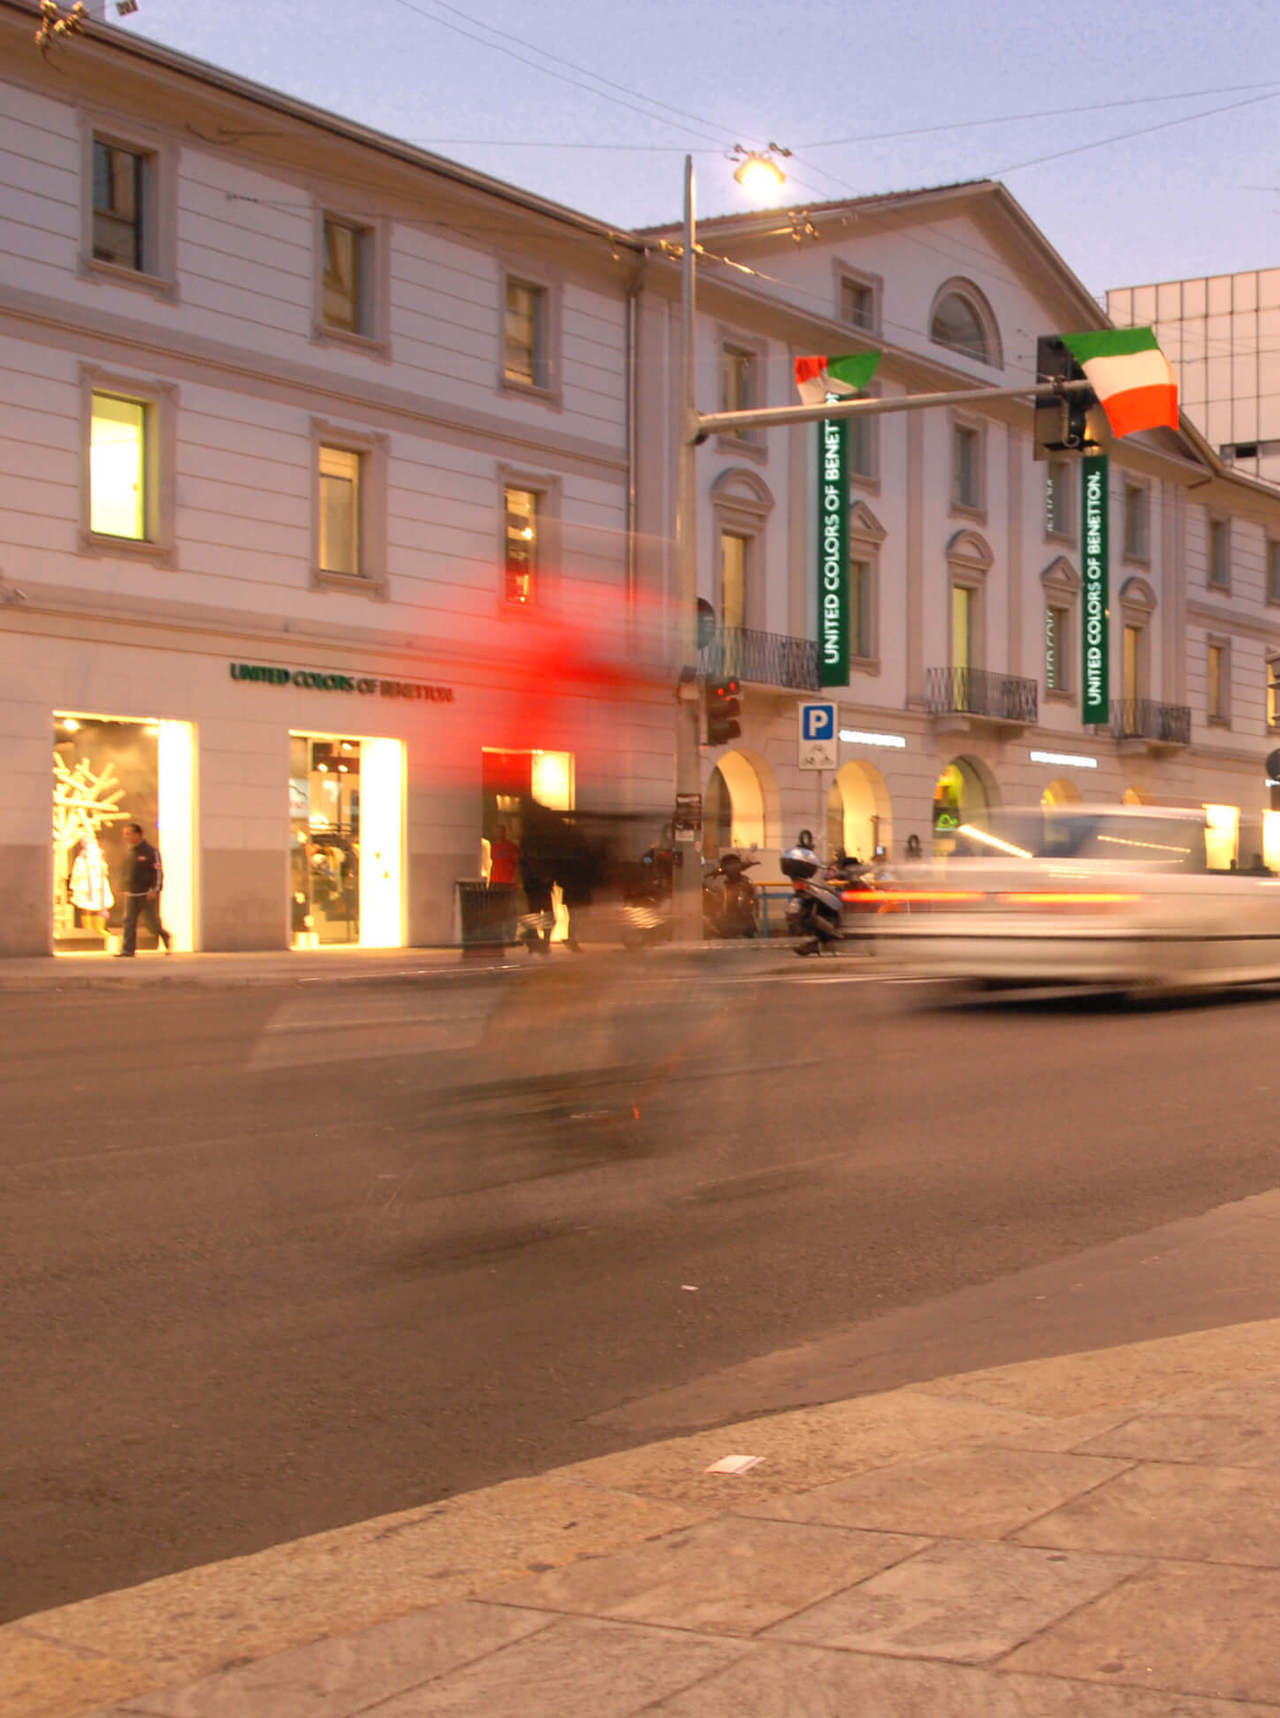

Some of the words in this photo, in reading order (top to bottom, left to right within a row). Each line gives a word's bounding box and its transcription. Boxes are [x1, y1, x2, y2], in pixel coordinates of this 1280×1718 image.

[824, 485, 840, 511] OF
[824, 513, 840, 591] COLORS
[1087, 557, 1101, 580] OF
[824, 593, 840, 664] UNITED
[1087, 581, 1102, 645] COLORS
[230, 662, 290, 685] UNITED
[293, 669, 355, 692] COLORS
[357, 677, 378, 694] OF
[1087, 647, 1102, 705] UNITED
[809, 709, 829, 736] P
